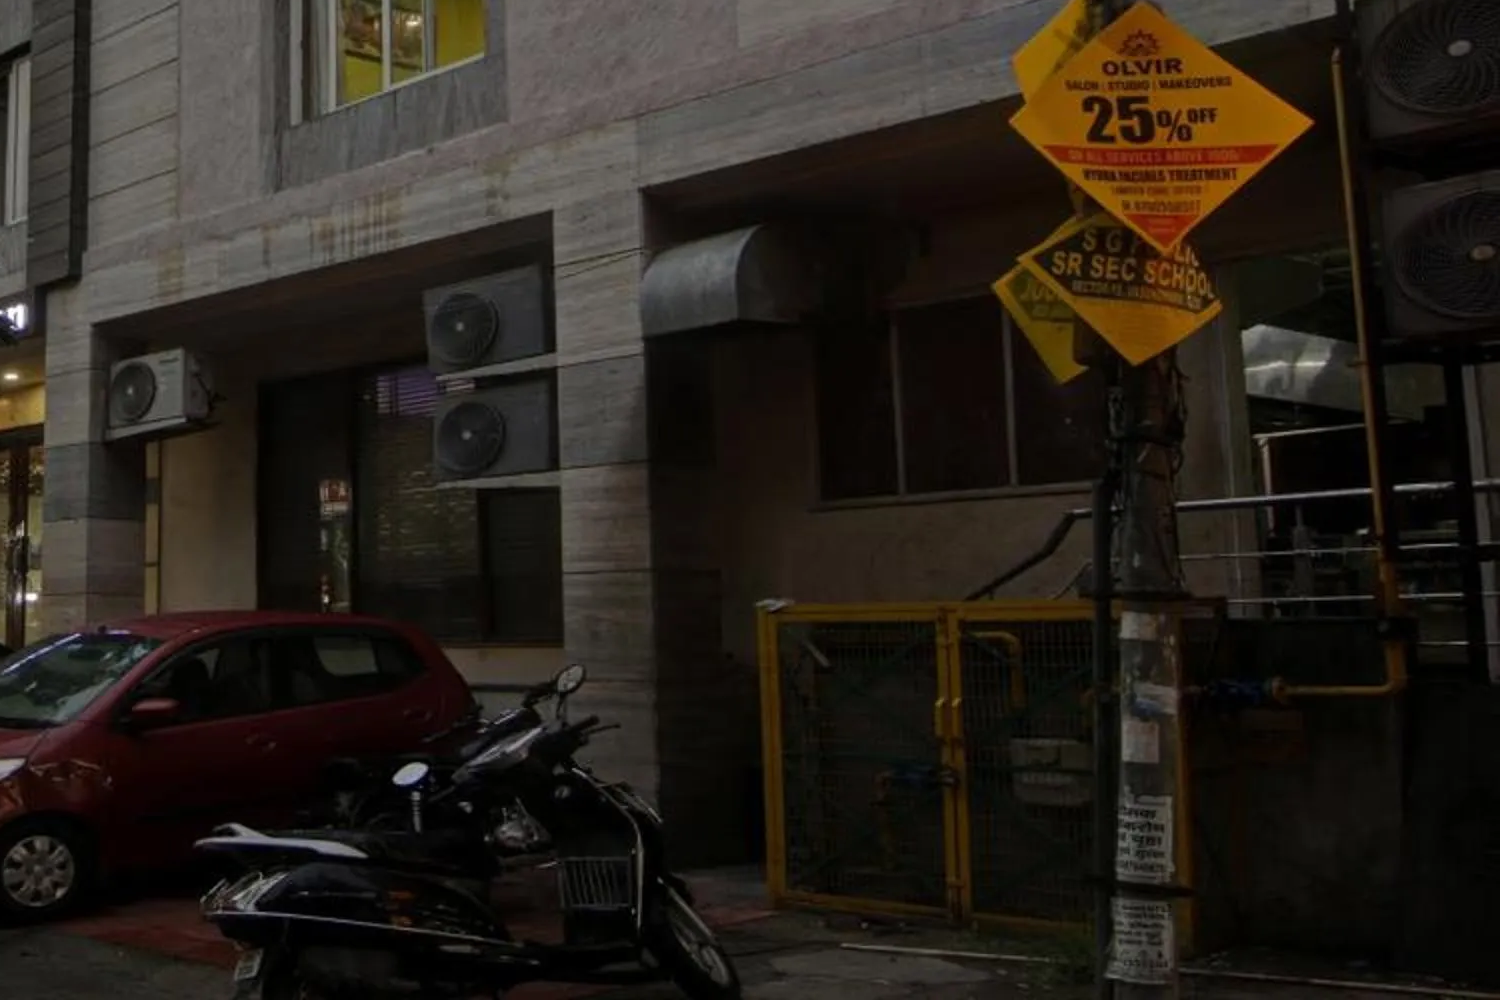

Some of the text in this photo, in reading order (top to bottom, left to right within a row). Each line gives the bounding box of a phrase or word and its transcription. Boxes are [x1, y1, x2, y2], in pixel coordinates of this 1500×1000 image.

[1102, 58, 1183, 75] OLVIR
[1187, 107, 1218, 123] OFF
[1052, 250, 1083, 278] SR
[1089, 254, 1138, 281] SEC
[1143, 260, 1216, 300] SCHOOL
